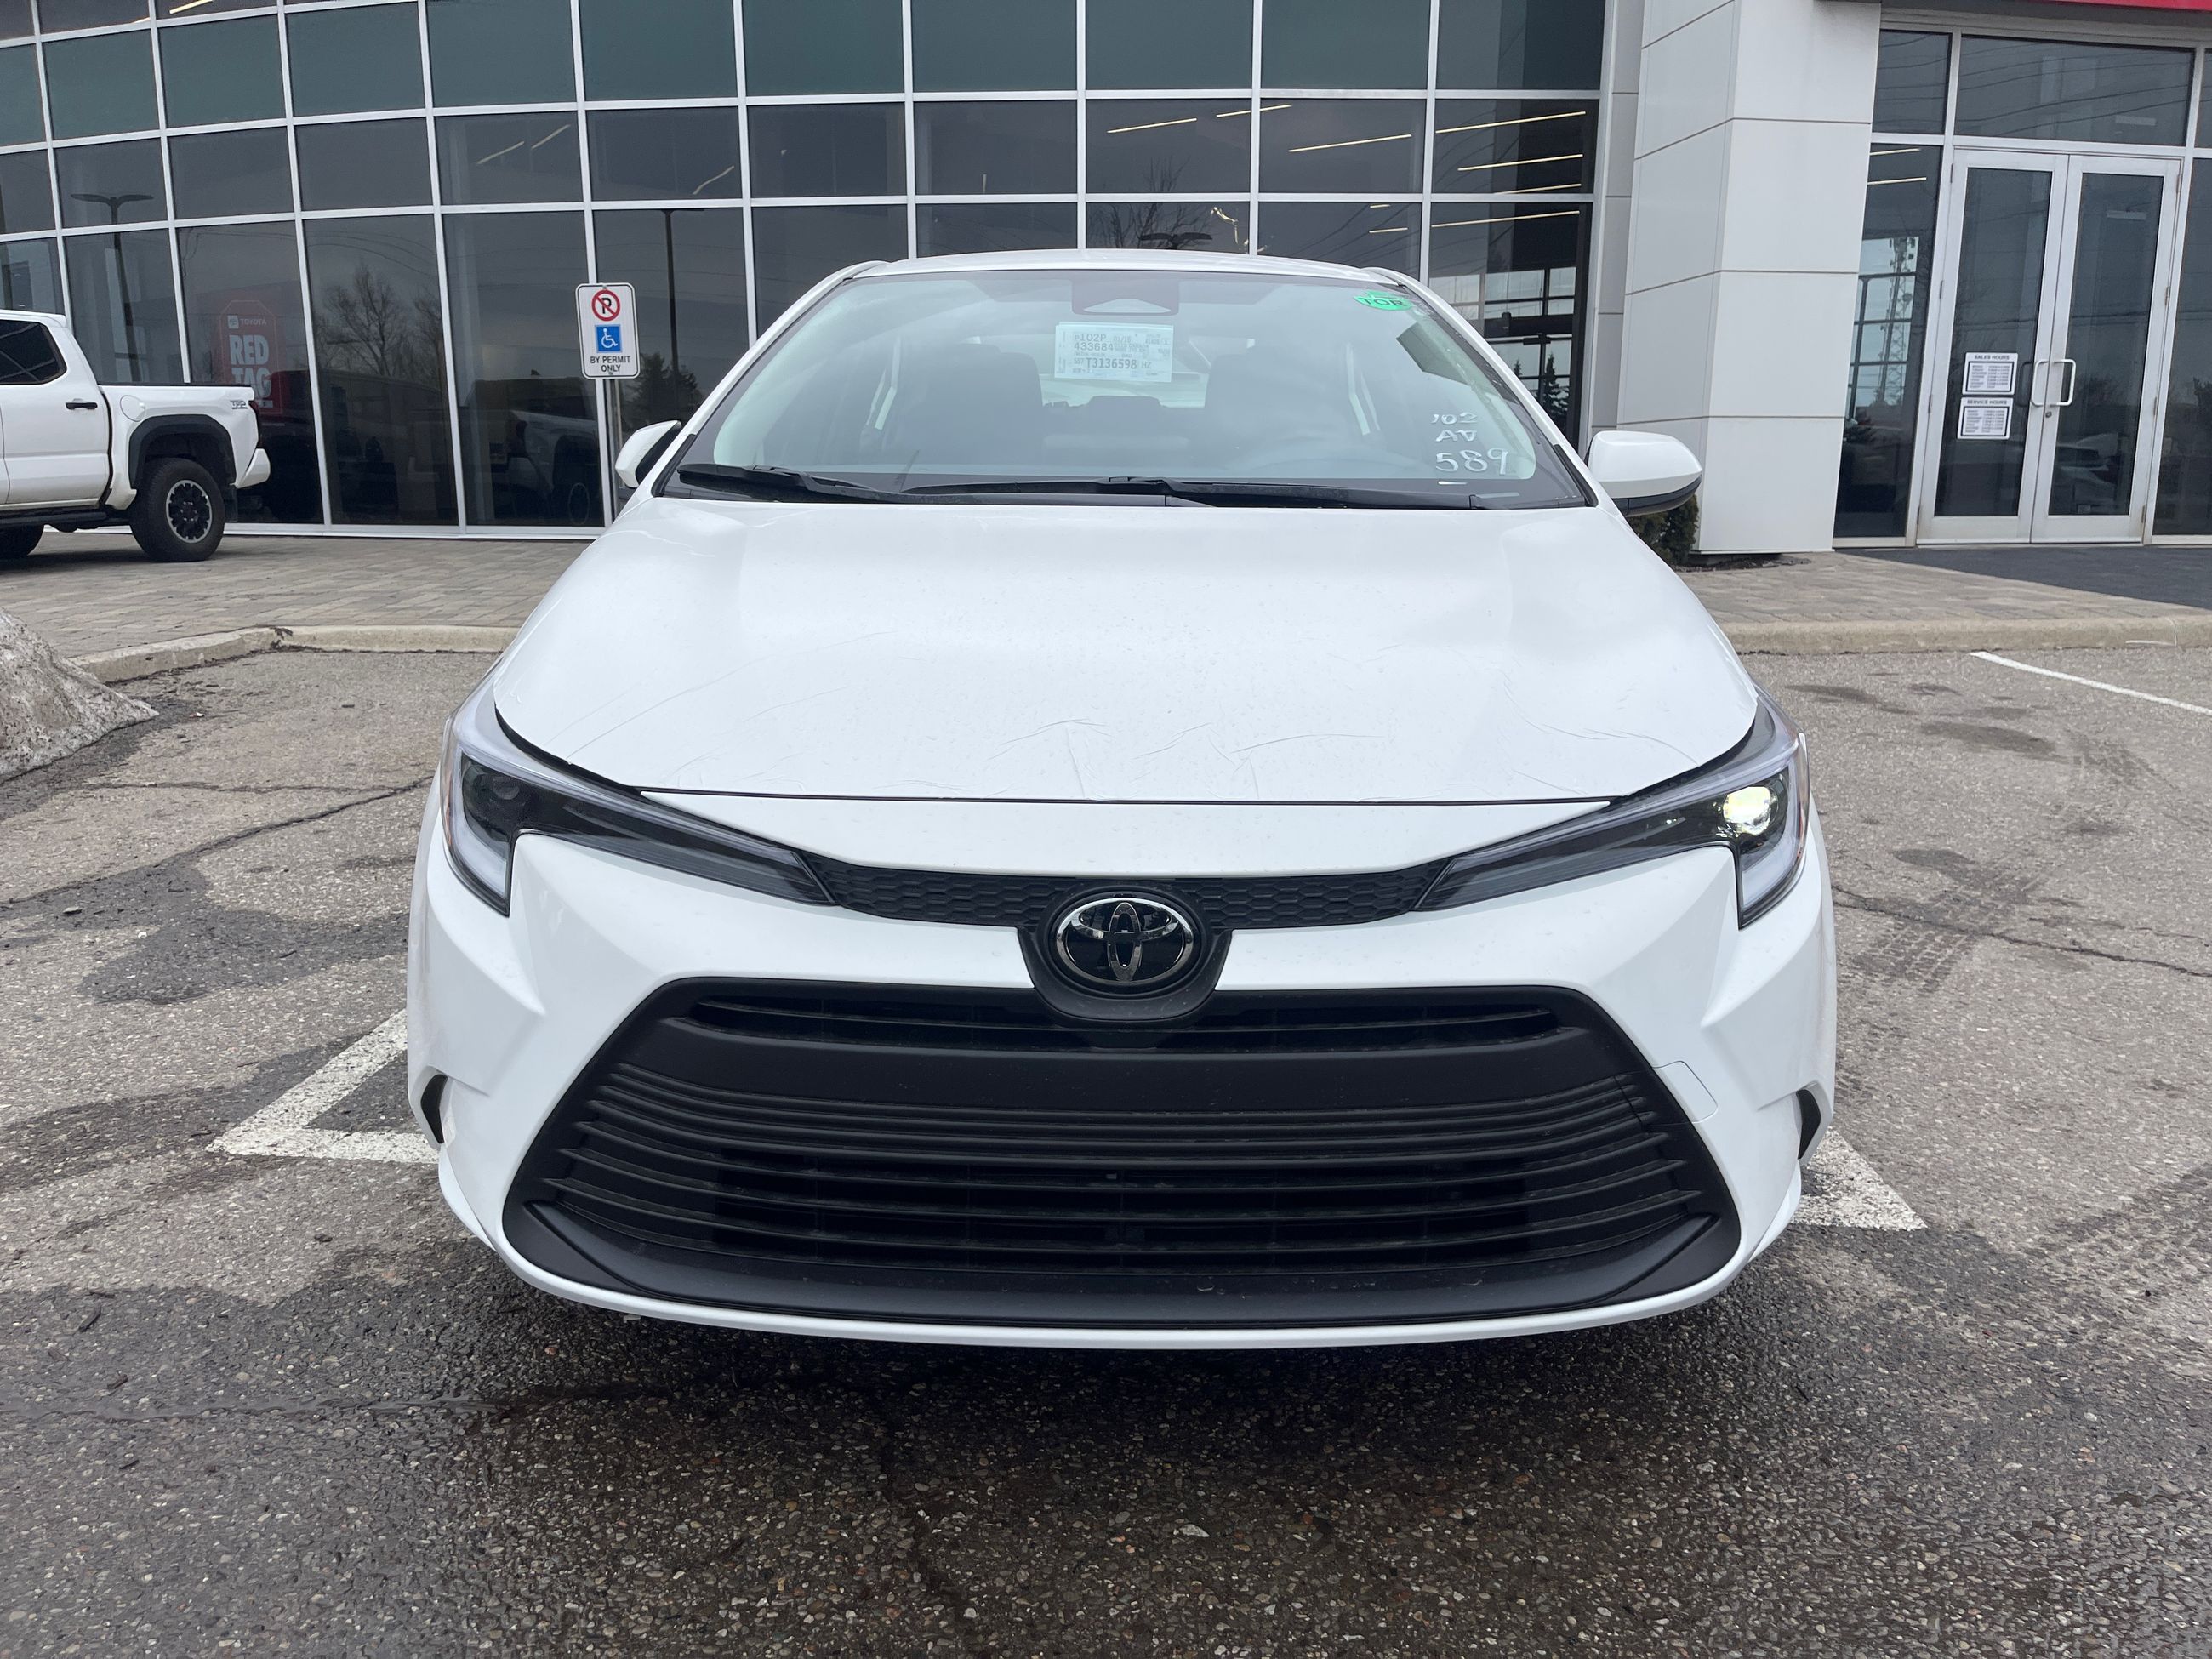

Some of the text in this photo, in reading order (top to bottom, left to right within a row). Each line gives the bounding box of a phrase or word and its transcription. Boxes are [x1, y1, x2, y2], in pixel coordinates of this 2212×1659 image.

[1358, 297, 1409, 307] TOR
[229, 334, 270, 365] RED
[1074, 342, 1114, 351] 433684
[590, 356, 600, 364] BY
[1086, 357, 1137, 369] T3136598
[601, 364, 621, 373] ONLY
[231, 367, 272, 398] TAG
[1435, 448, 1509, 475] 589
